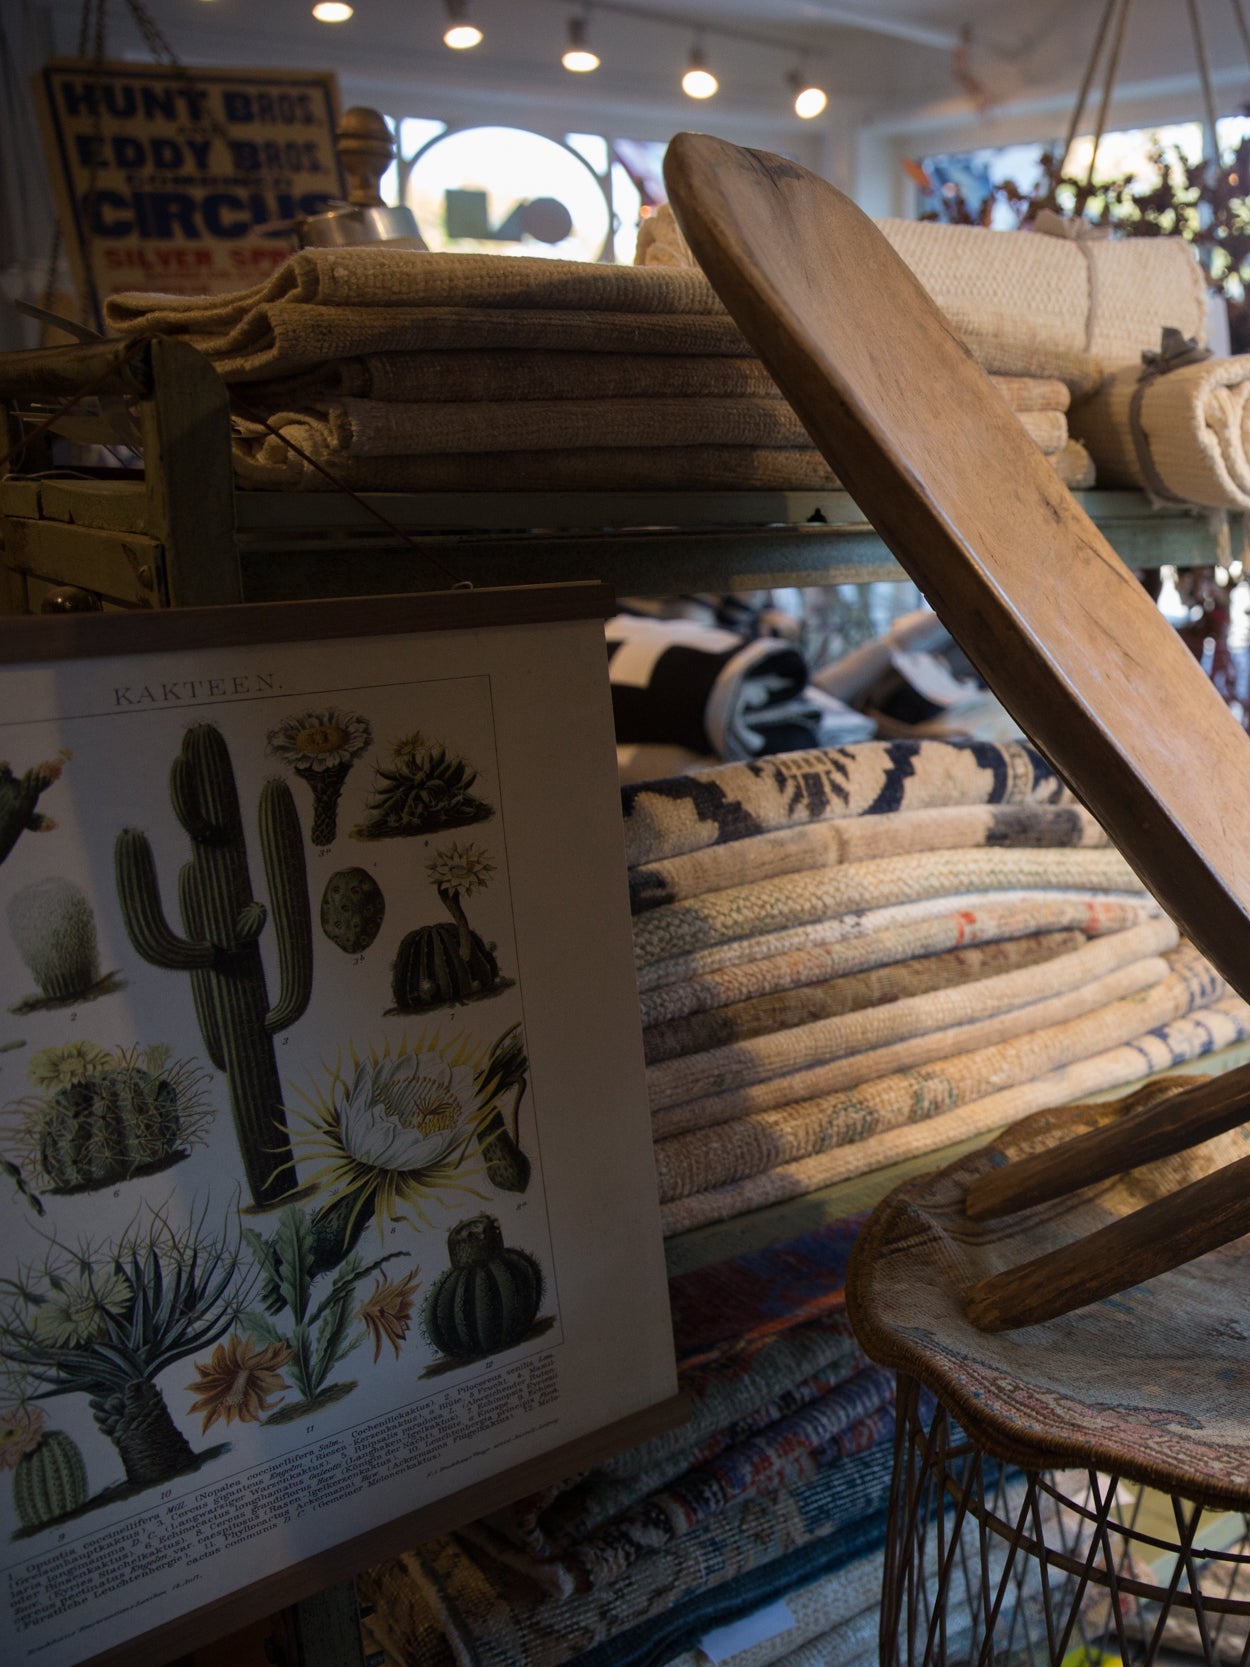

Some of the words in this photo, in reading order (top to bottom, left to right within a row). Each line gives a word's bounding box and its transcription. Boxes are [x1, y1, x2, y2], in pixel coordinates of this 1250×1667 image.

[62, 82, 207, 121] HUNT
[75, 135, 211, 171] EDDY
[105, 248, 214, 271] SILVER
[25, 1545, 76, 1573] Opuntia
[194, 1477, 241, 1503] (Nopalea
[457, 1371, 502, 1395] Pilocereus
[160, 1488, 173, 1500] 10
[208, 1510, 246, 1531] Cereus
[250, 1482, 312, 1515] grandiflorus
[383, 1444, 401, 1457] der
[9, 1578, 41, 1599] laria
[45, 1543, 125, 1583] longimamma
[354, 1429, 398, 1453] Rhipsalis
[401, 1411, 443, 1435] paradoxa
[170, 1500, 208, 1522] Cereus
[212, 1477, 264, 1505] giganteus
[9, 1588, 40, 1607] oder
[158, 1508, 230, 1543] Echinocactus
[234, 1477, 304, 1512] longihamatus
[185, 1545, 221, 1566] cactus
[224, 1520, 278, 1550] communis
[59, 1570, 125, 1605] pectinatus
